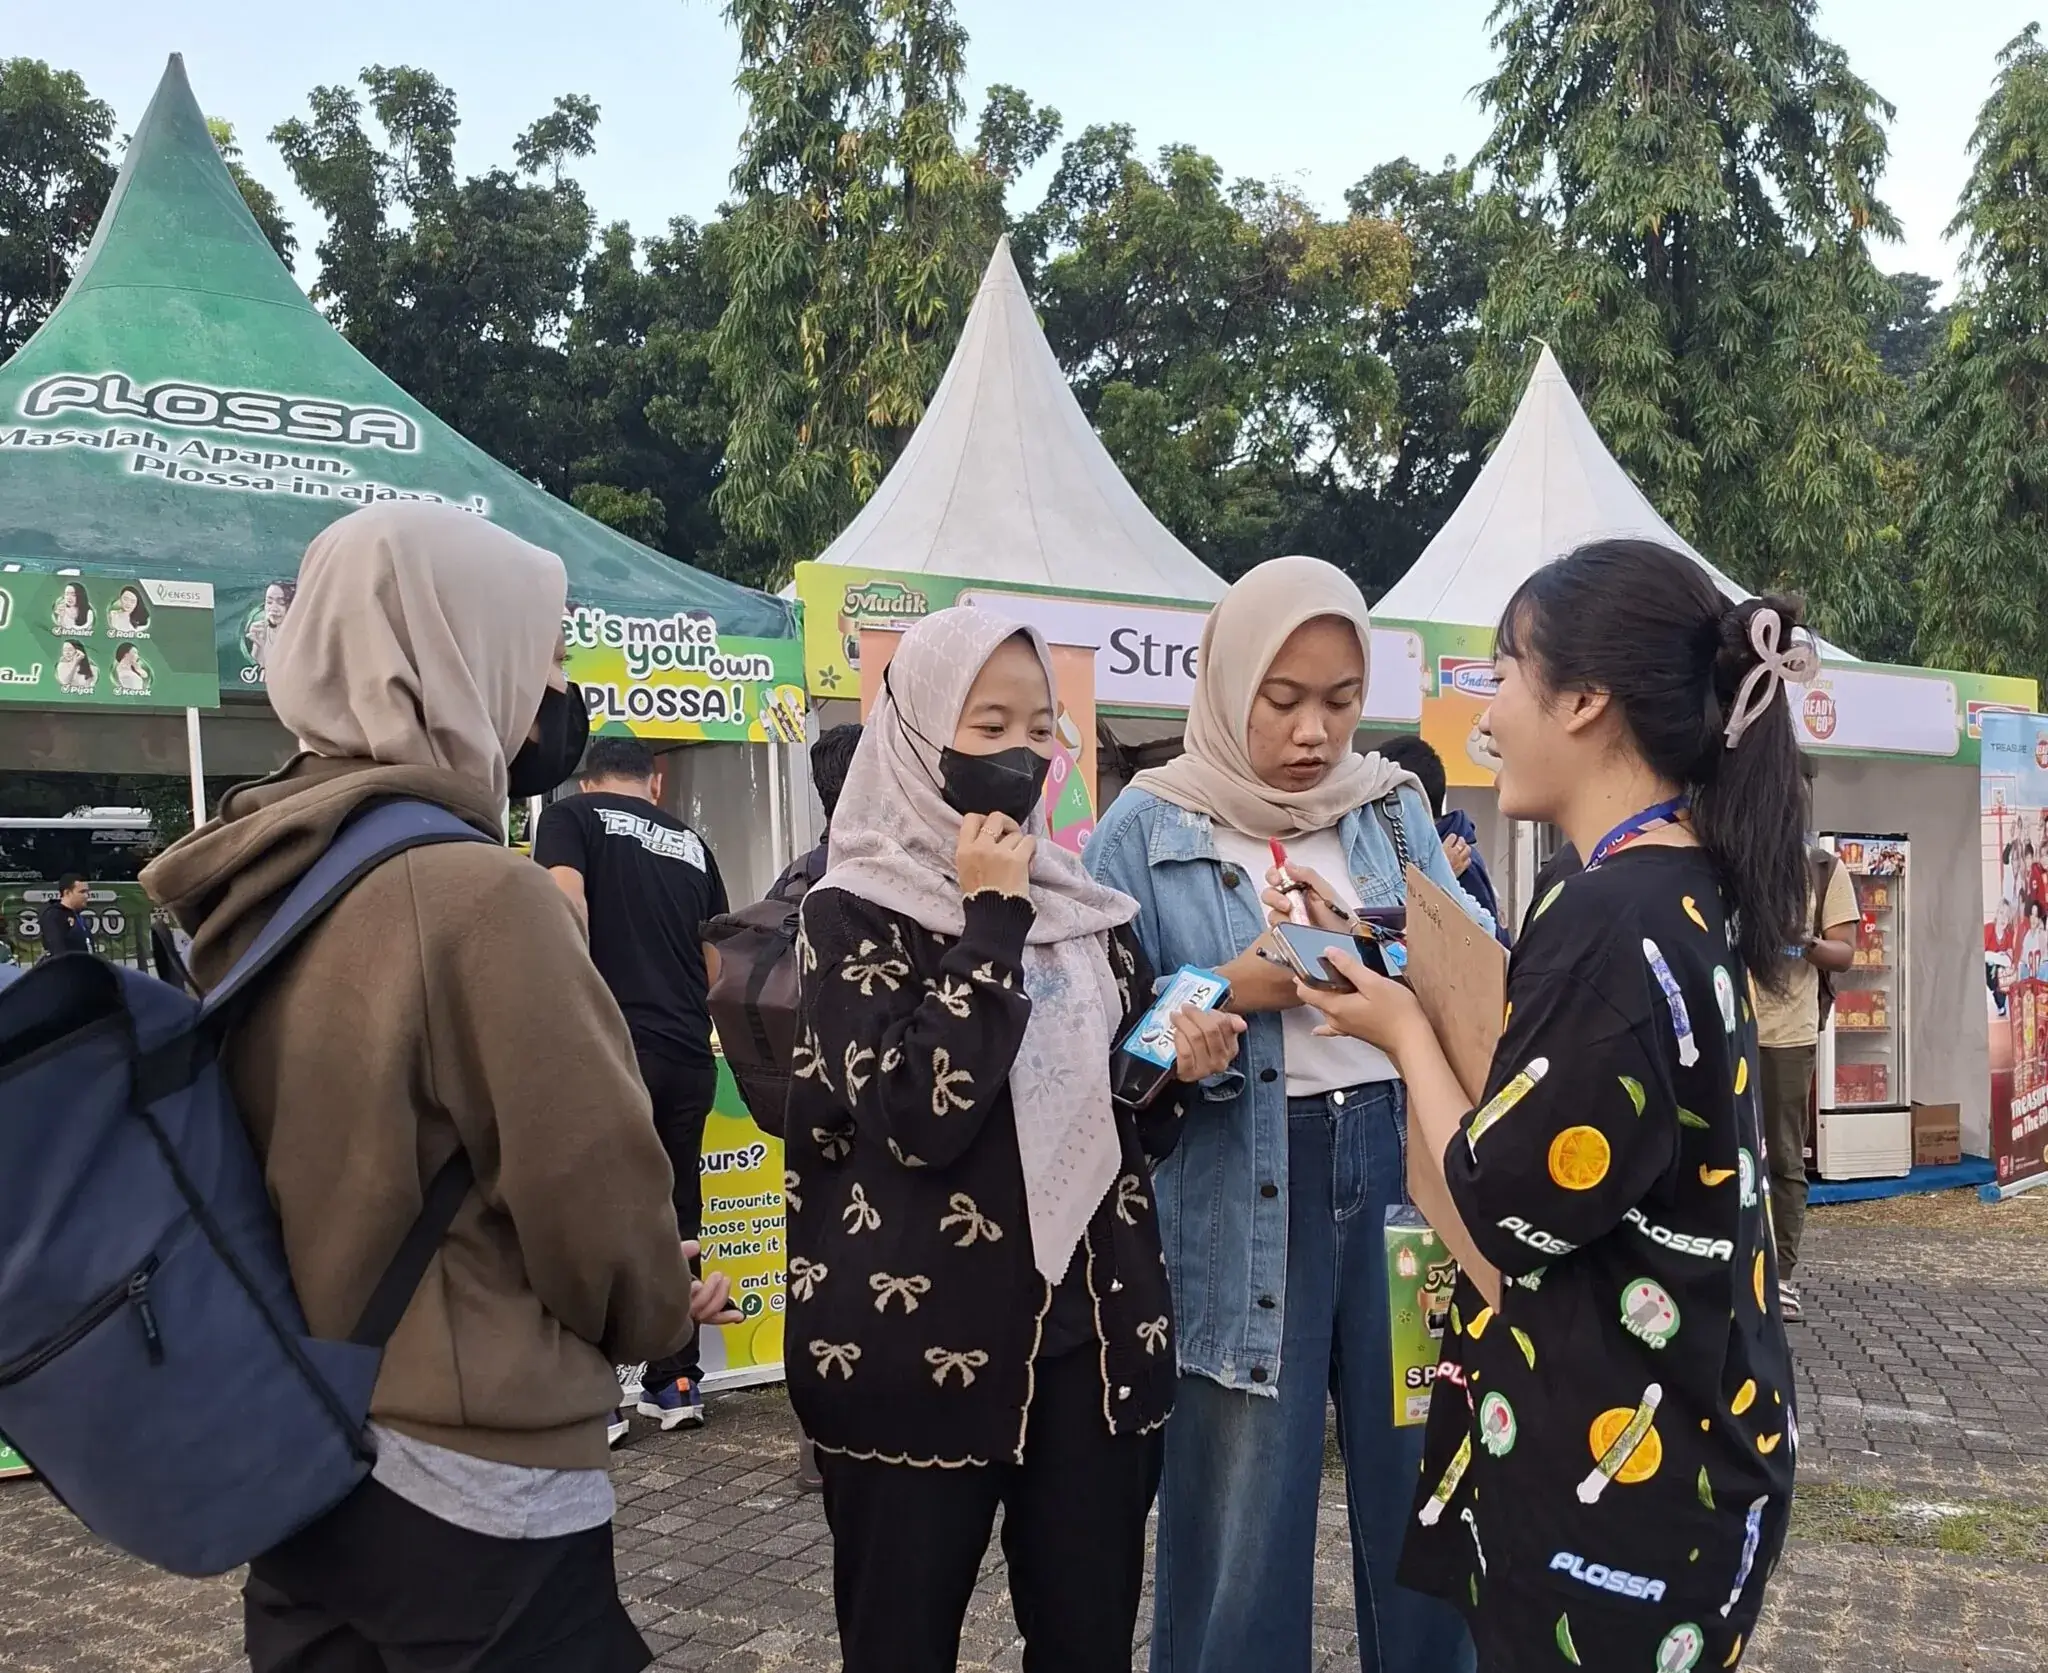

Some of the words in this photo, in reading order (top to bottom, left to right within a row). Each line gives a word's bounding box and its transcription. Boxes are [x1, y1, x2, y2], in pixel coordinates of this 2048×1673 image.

[26, 375, 414, 449] PLOSSA
[0, 428, 168, 453] Masalah
[178, 440, 354, 477] Apapun,
[133, 454, 330, 496] Plossa-in
[843, 592, 927, 614] Mudik
[61, 626, 94, 637] Inhaler
[116, 630, 135, 639] Roll
[137, 631, 151, 639] On
[628, 614, 712, 643] make
[628, 644, 716, 675] your
[709, 657, 770, 677] own
[1109, 627, 1199, 679] Stre
[70, 685, 94, 695] Pijat
[122, 686, 152, 697] Kerok
[1803, 699, 1835, 716] READY
[700, 1144, 766, 1172] ours?
[710, 1194, 781, 1212] Favourite
[700, 1221, 745, 1236] hoose
[752, 1216, 786, 1235] your
[1496, 1215, 1581, 1255] PLOSS
[1622, 1207, 1735, 1262] PLOSSA
[719, 1240, 760, 1258] Make
[767, 1238, 779, 1251] it
[741, 1272, 768, 1288] and
[1620, 1314, 1667, 1350] Hirup
[1549, 1551, 1667, 1602] PLOSSA
